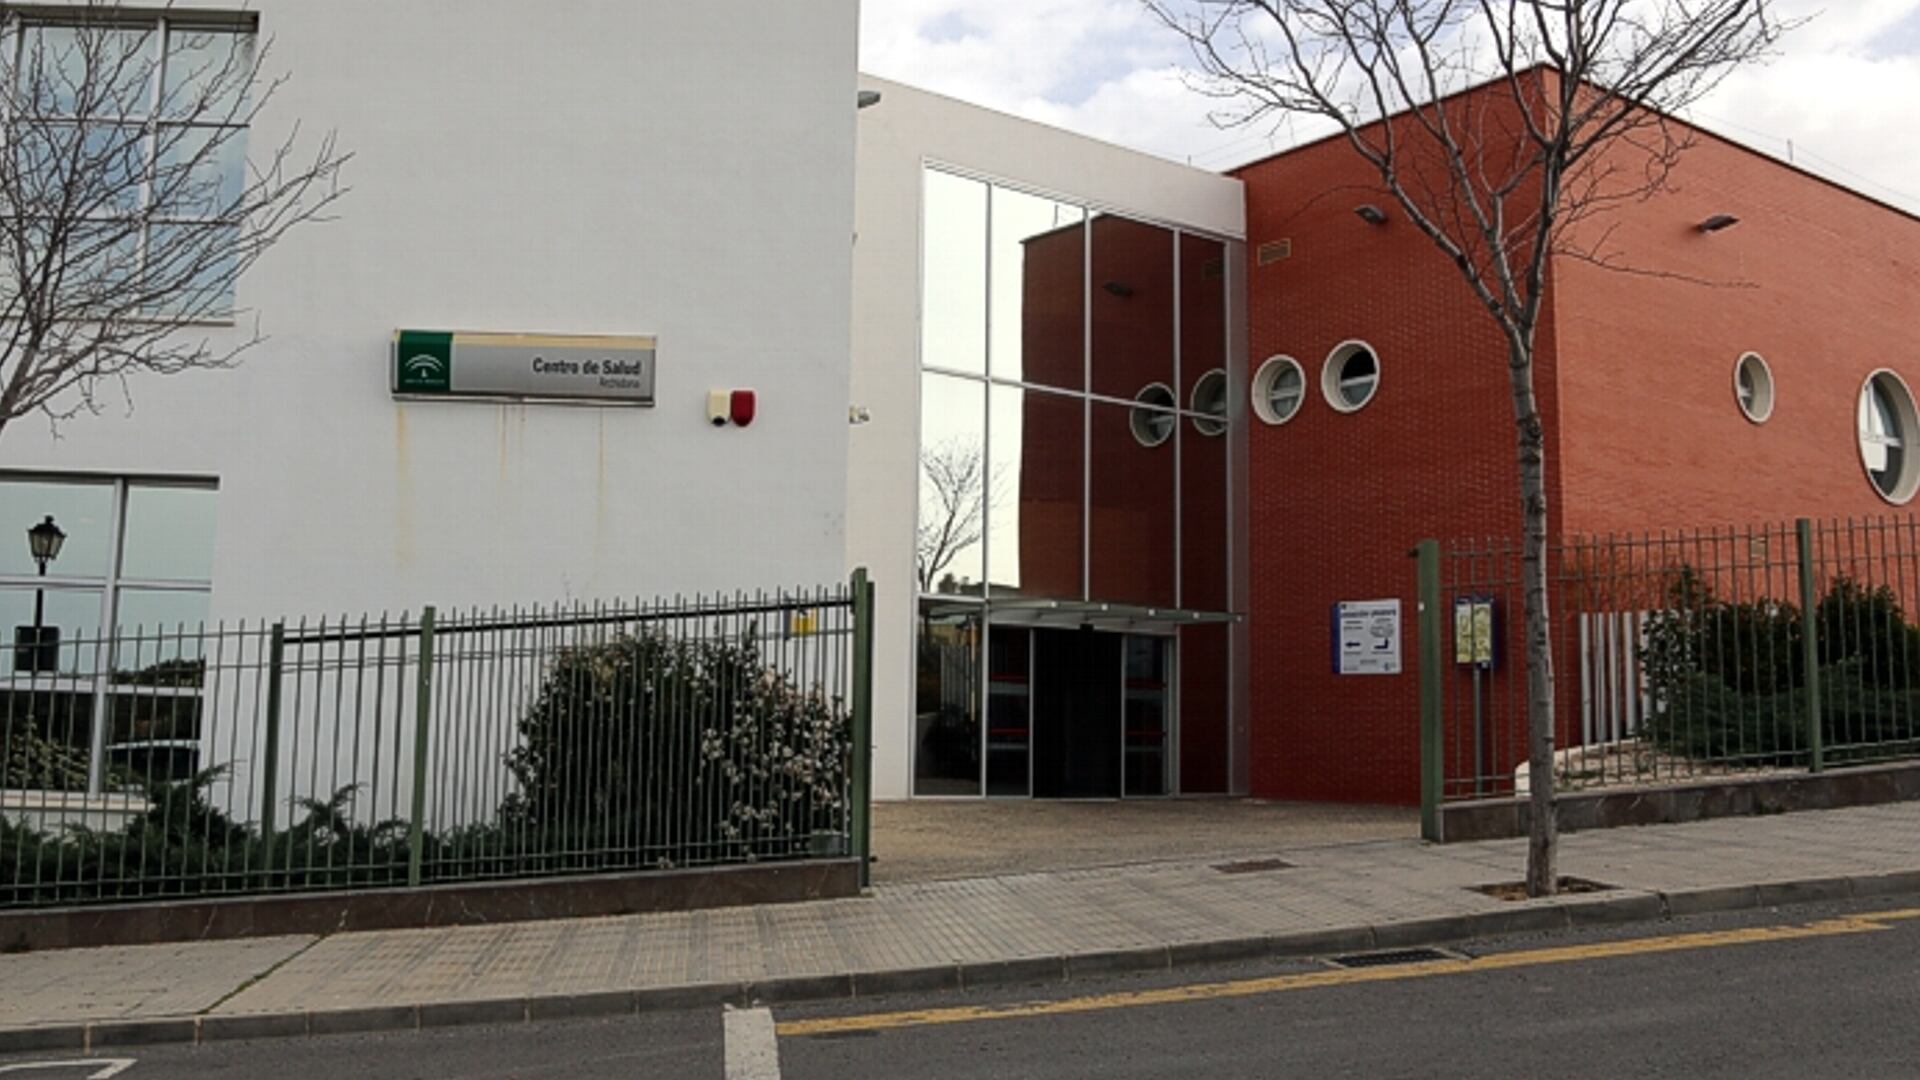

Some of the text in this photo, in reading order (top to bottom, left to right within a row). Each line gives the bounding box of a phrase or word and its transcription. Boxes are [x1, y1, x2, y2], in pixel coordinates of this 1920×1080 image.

[532, 357, 642, 375] Centro de Salud
